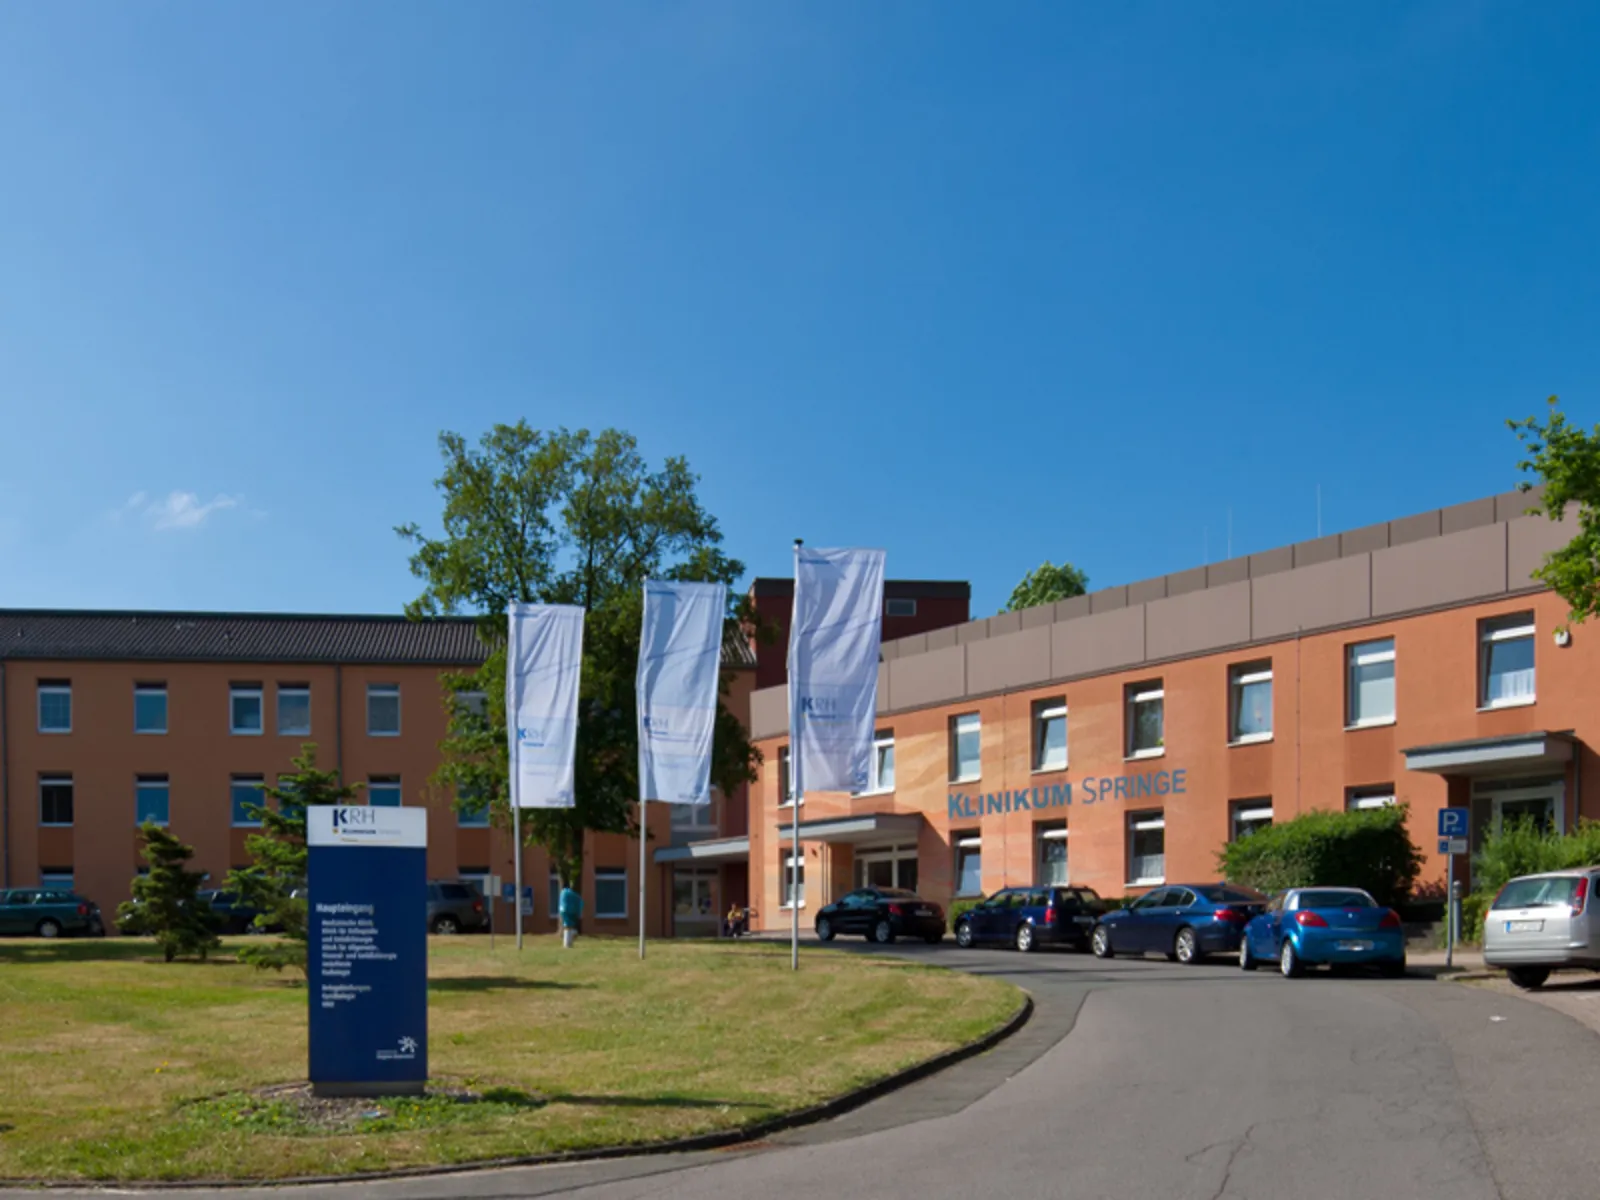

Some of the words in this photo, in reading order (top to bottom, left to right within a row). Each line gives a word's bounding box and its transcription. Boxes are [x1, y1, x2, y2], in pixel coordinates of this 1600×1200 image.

[948, 783, 1072, 819] KLINIKUM
[1082, 769, 1187, 804] SPRINGE
[333, 808, 376, 827] KRH
[1443, 812, 1459, 833] P
